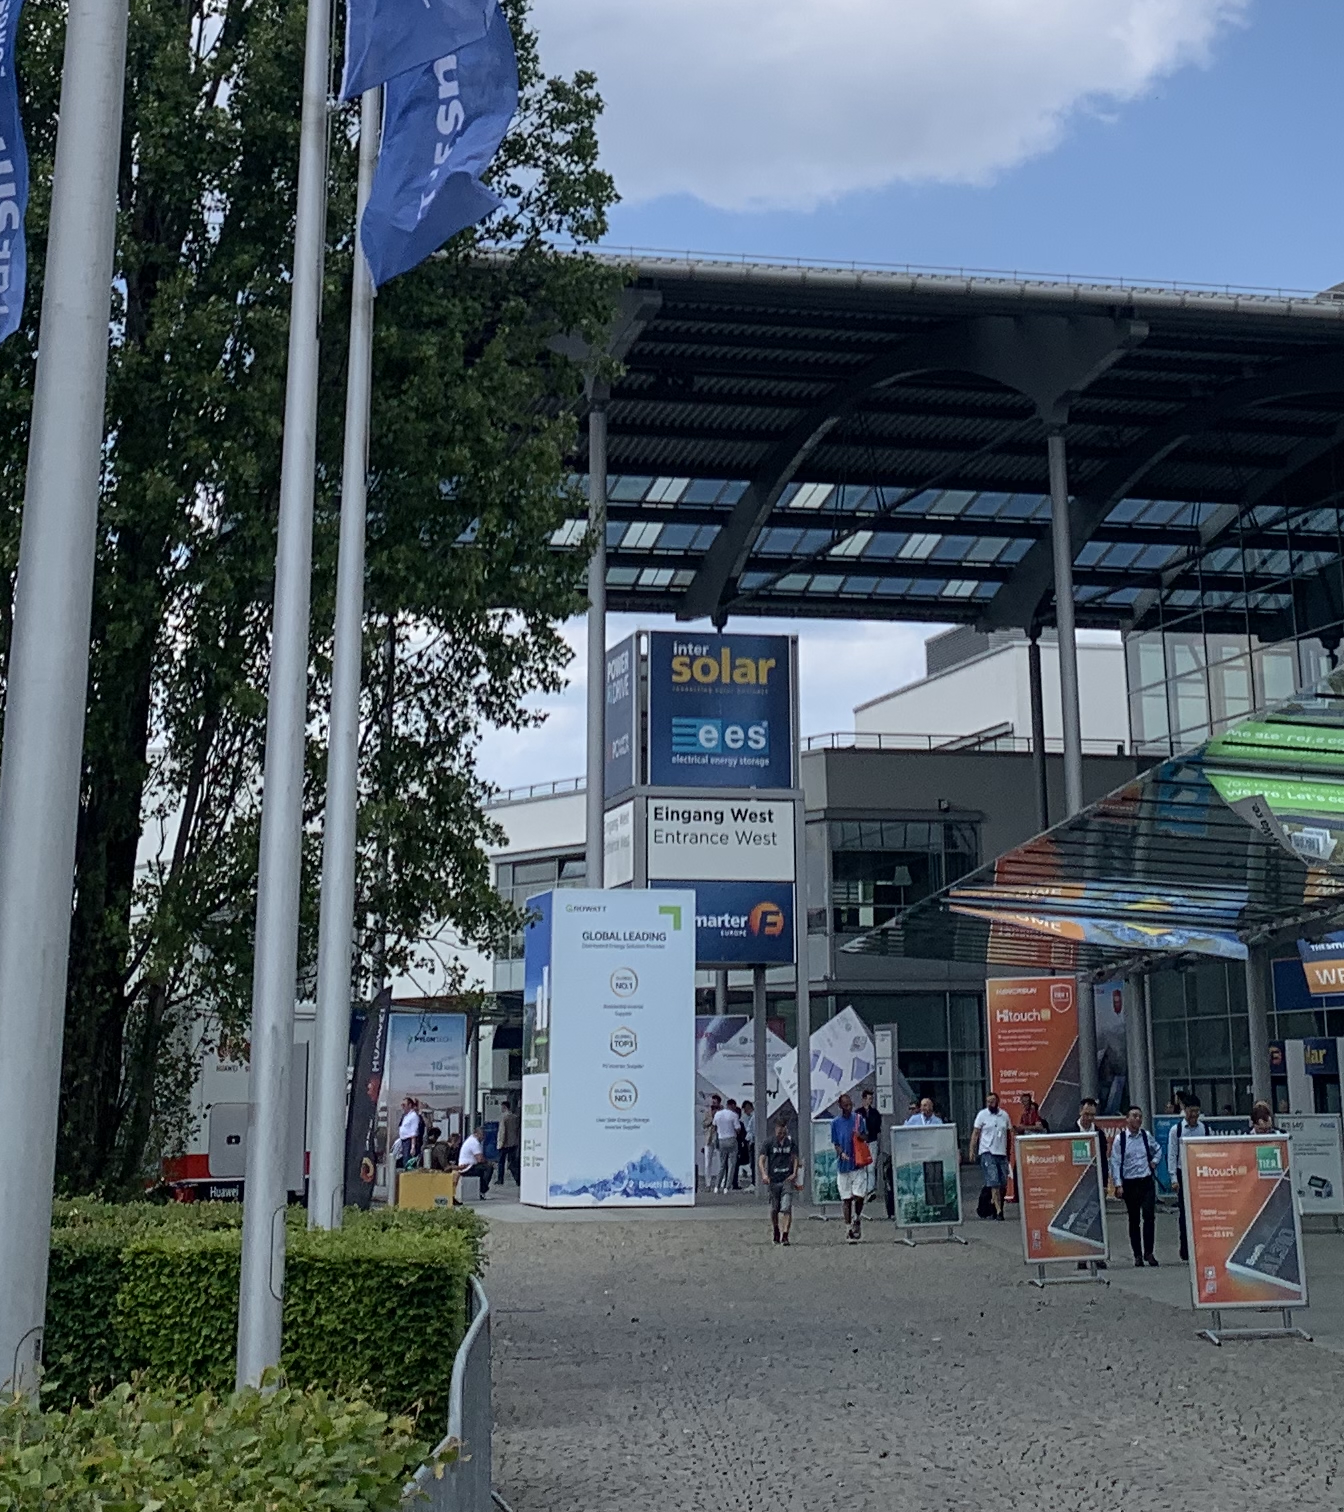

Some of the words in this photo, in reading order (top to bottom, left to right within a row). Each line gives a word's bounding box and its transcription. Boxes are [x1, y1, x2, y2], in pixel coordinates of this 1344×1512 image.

[673, 640, 709, 656] inter
[671, 646, 776, 685] solar
[698, 723, 767, 750] ees
[672, 754, 709, 765] electrical
[710, 757, 738, 768] energy
[739, 756, 770, 767] storage
[1226, 787, 1251, 798] We
[1287, 791, 1326, 803] Let's
[654, 806, 724, 824] Eingang
[731, 808, 774, 823] West
[654, 829, 729, 845] Entrance
[735, 830, 777, 846] West
[695, 914, 748, 929] marter
[582, 931, 621, 941] GLOBAL
[623, 931, 667, 941] LEADING
[720, 929, 747, 937] EUROPE
[996, 1008, 1041, 1023] Hitouch
[1305, 1044, 1327, 1065] lar
[1196, 1165, 1239, 1177] Hitouch
[210, 1185, 239, 1198] Huawei
